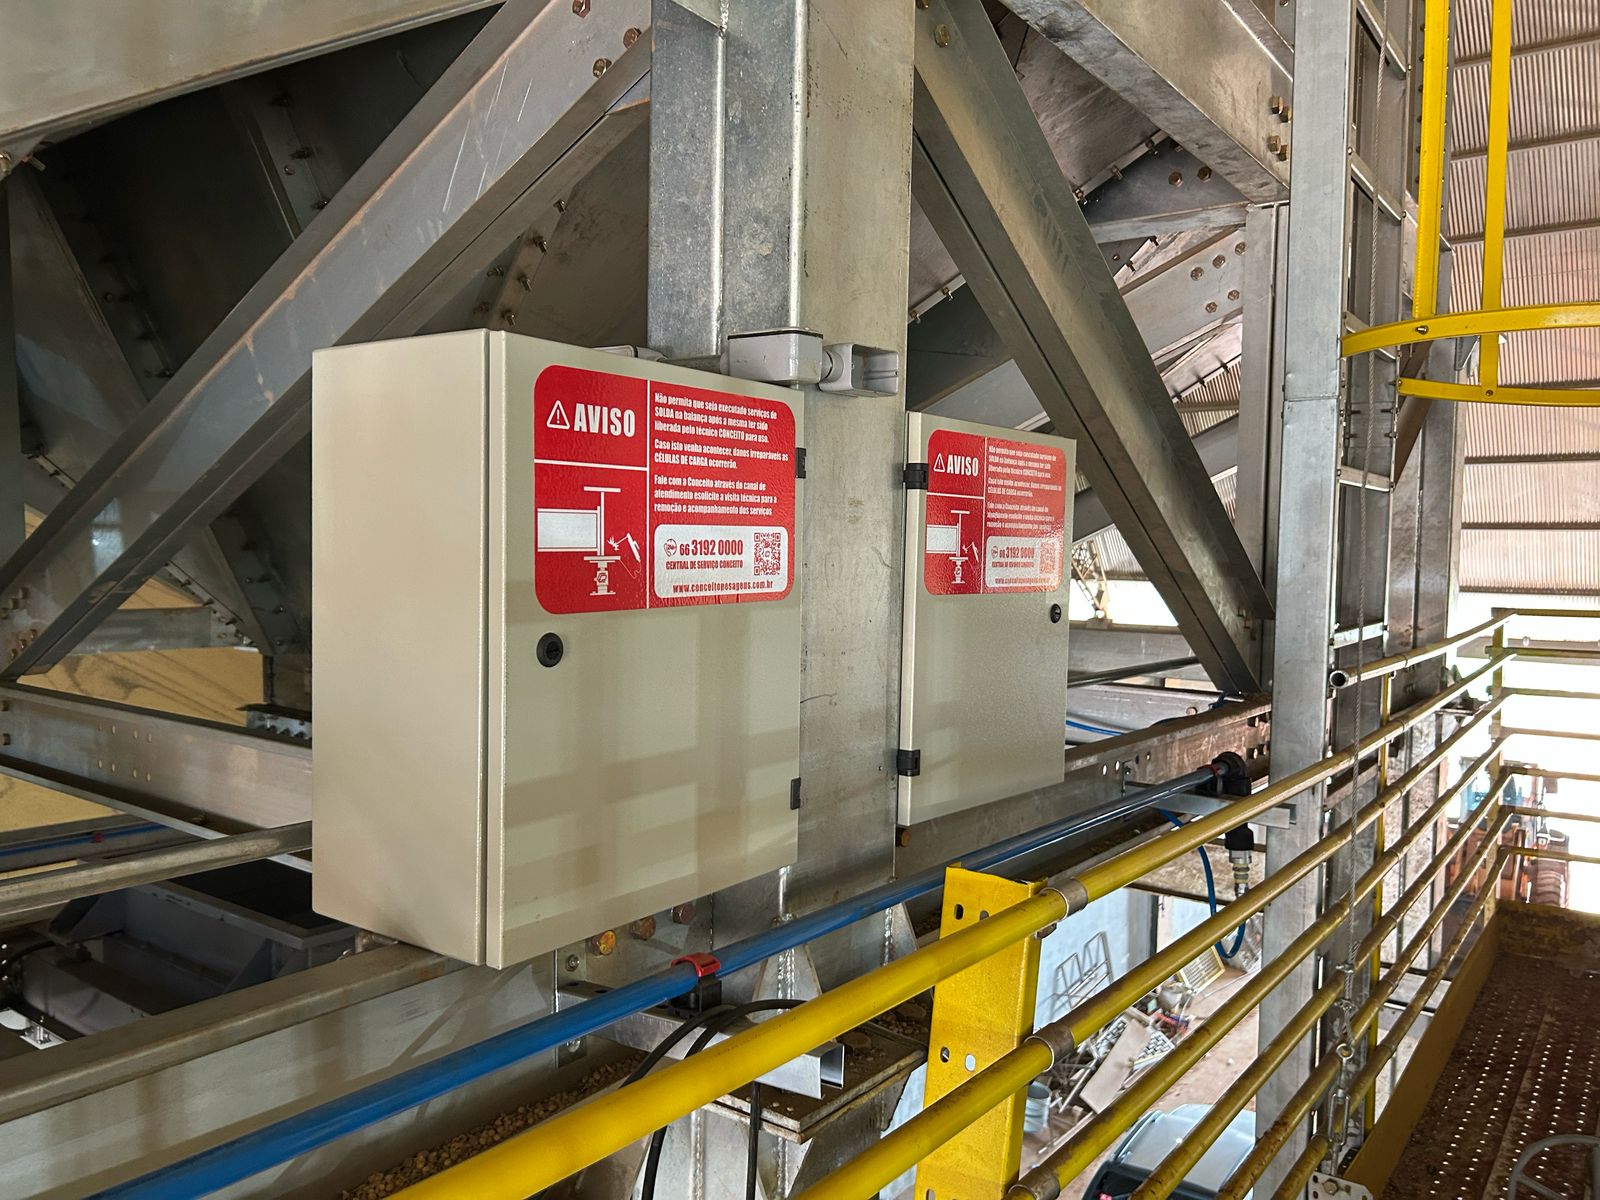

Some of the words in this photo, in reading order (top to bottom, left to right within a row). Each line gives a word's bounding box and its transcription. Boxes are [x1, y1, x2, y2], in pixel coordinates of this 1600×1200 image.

[654, 392, 667, 404] Não
[668, 395, 692, 407] permita
[693, 399, 704, 409] que
[705, 401, 717, 411] seja
[719, 403, 747, 415] executado
[748, 407, 770, 419] serviços
[770, 410, 777, 419] de
[574, 403, 635, 438] AVISO
[654, 406, 674, 417] SOLDA
[675, 410, 683, 419] na
[684, 411, 707, 423] balança
[708, 414, 722, 424] após
[723, 417, 727, 425] a
[728, 418, 748, 428] mesma
[756, 422, 768, 430] sido
[654, 420, 680, 432] liberada
[682, 424, 695, 434] pelo
[696, 426, 718, 437] técnico
[719, 429, 744, 440] CONCEITO
[745, 433, 757, 442] para
[654, 439, 670, 449] Caso
[671, 441, 683, 450] isto
[684, 443, 702, 453] venha
[733, 448, 749, 457] danos
[782, 453, 788, 461] as
[654, 452, 680, 464] CÉLULAS
[680, 455, 688, 464] DE
[689, 456, 708, 466] CARGA
[709, 458, 737, 469] ocorrerão.
[947, 455, 978, 476] AVISO
[654, 475, 667, 485] Fale
[668, 476, 682, 485] com
[688, 477, 713, 488] Conceito
[714, 479, 735, 489] através
[736, 480, 743, 489] do
[744, 481, 758, 490] canal
[759, 482, 766, 490] de
[654, 490, 693, 500] atendimento
[725, 492, 740, 501] visita
[740, 493, 760, 502] técnica
[654, 503, 682, 514] remoção
[682, 504, 686, 512] e
[688, 504, 738, 514] acompanhamento
[739, 504, 749, 515] dos
[750, 506, 772, 516] serviços
[680, 544, 690, 555] 66
[692, 539, 716, 556] 3192
[718, 540, 744, 555] 0000
[666, 561, 689, 569] CENTRAL
[690, 561, 696, 569] DE
[697, 560, 718, 570] SERVIÇO
[720, 560, 743, 568] CONCEITO
[673, 580, 773, 593] www.conceitopesagens.com.br
